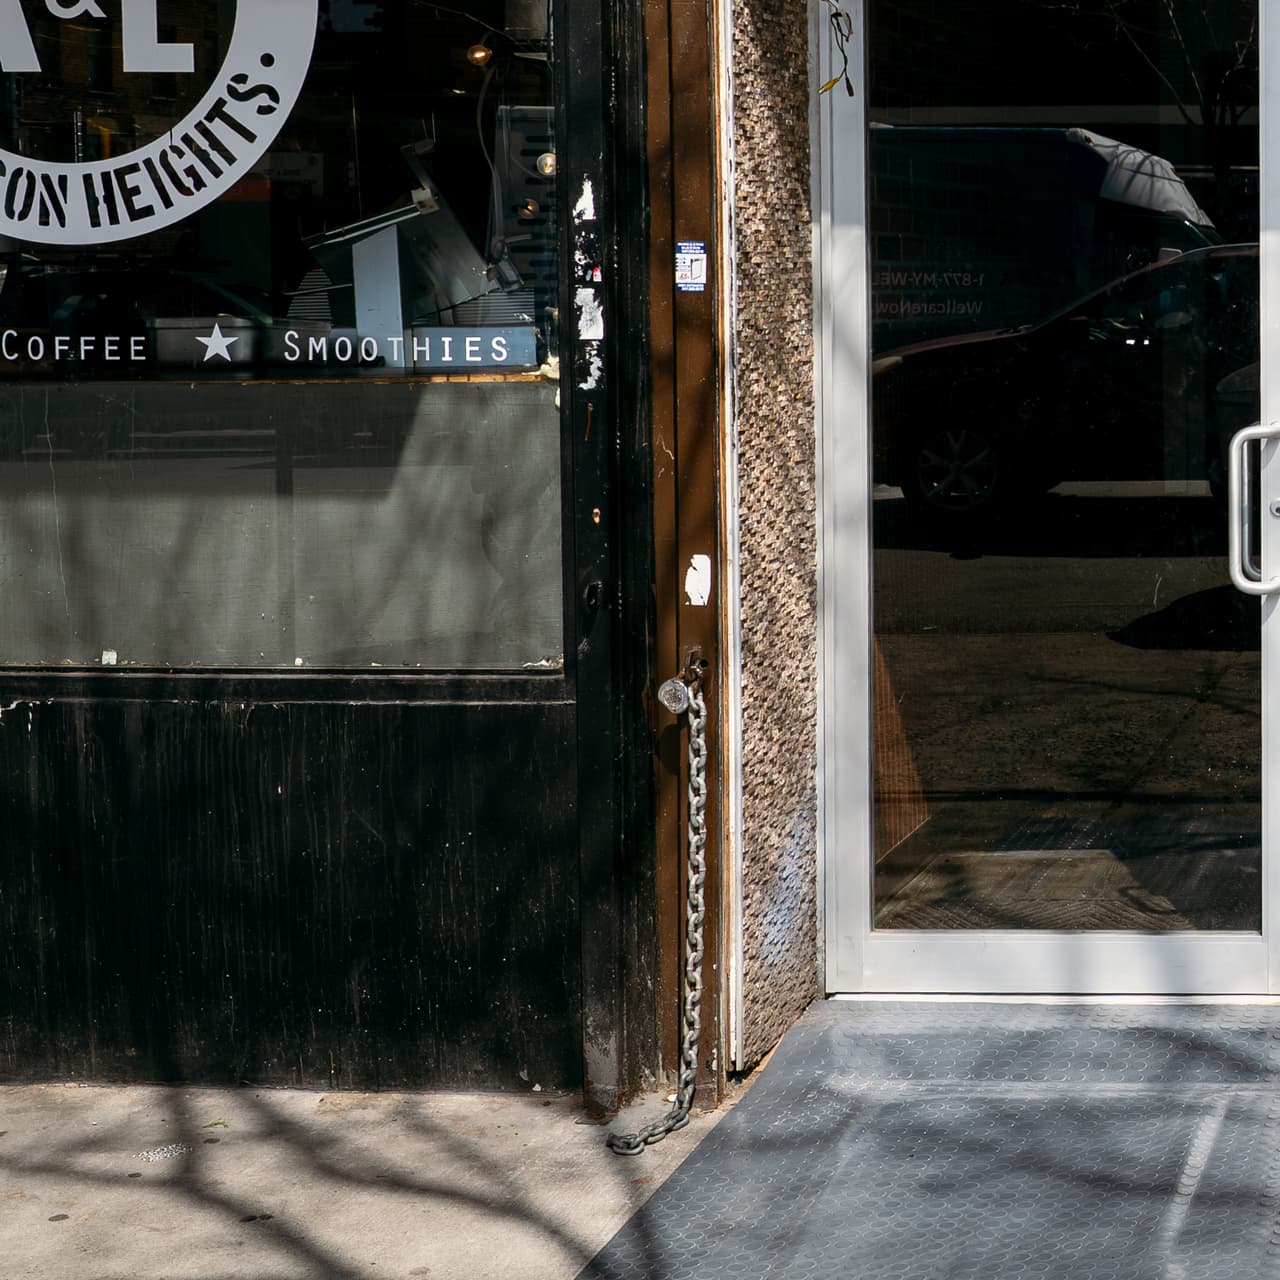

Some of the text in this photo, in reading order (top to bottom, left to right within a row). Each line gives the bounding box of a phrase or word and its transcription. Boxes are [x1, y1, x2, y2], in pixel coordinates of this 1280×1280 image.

[83, 72, 280, 228] HEIGHTS
[2, 329, 509, 362] COFFEE SMOOTHIES
